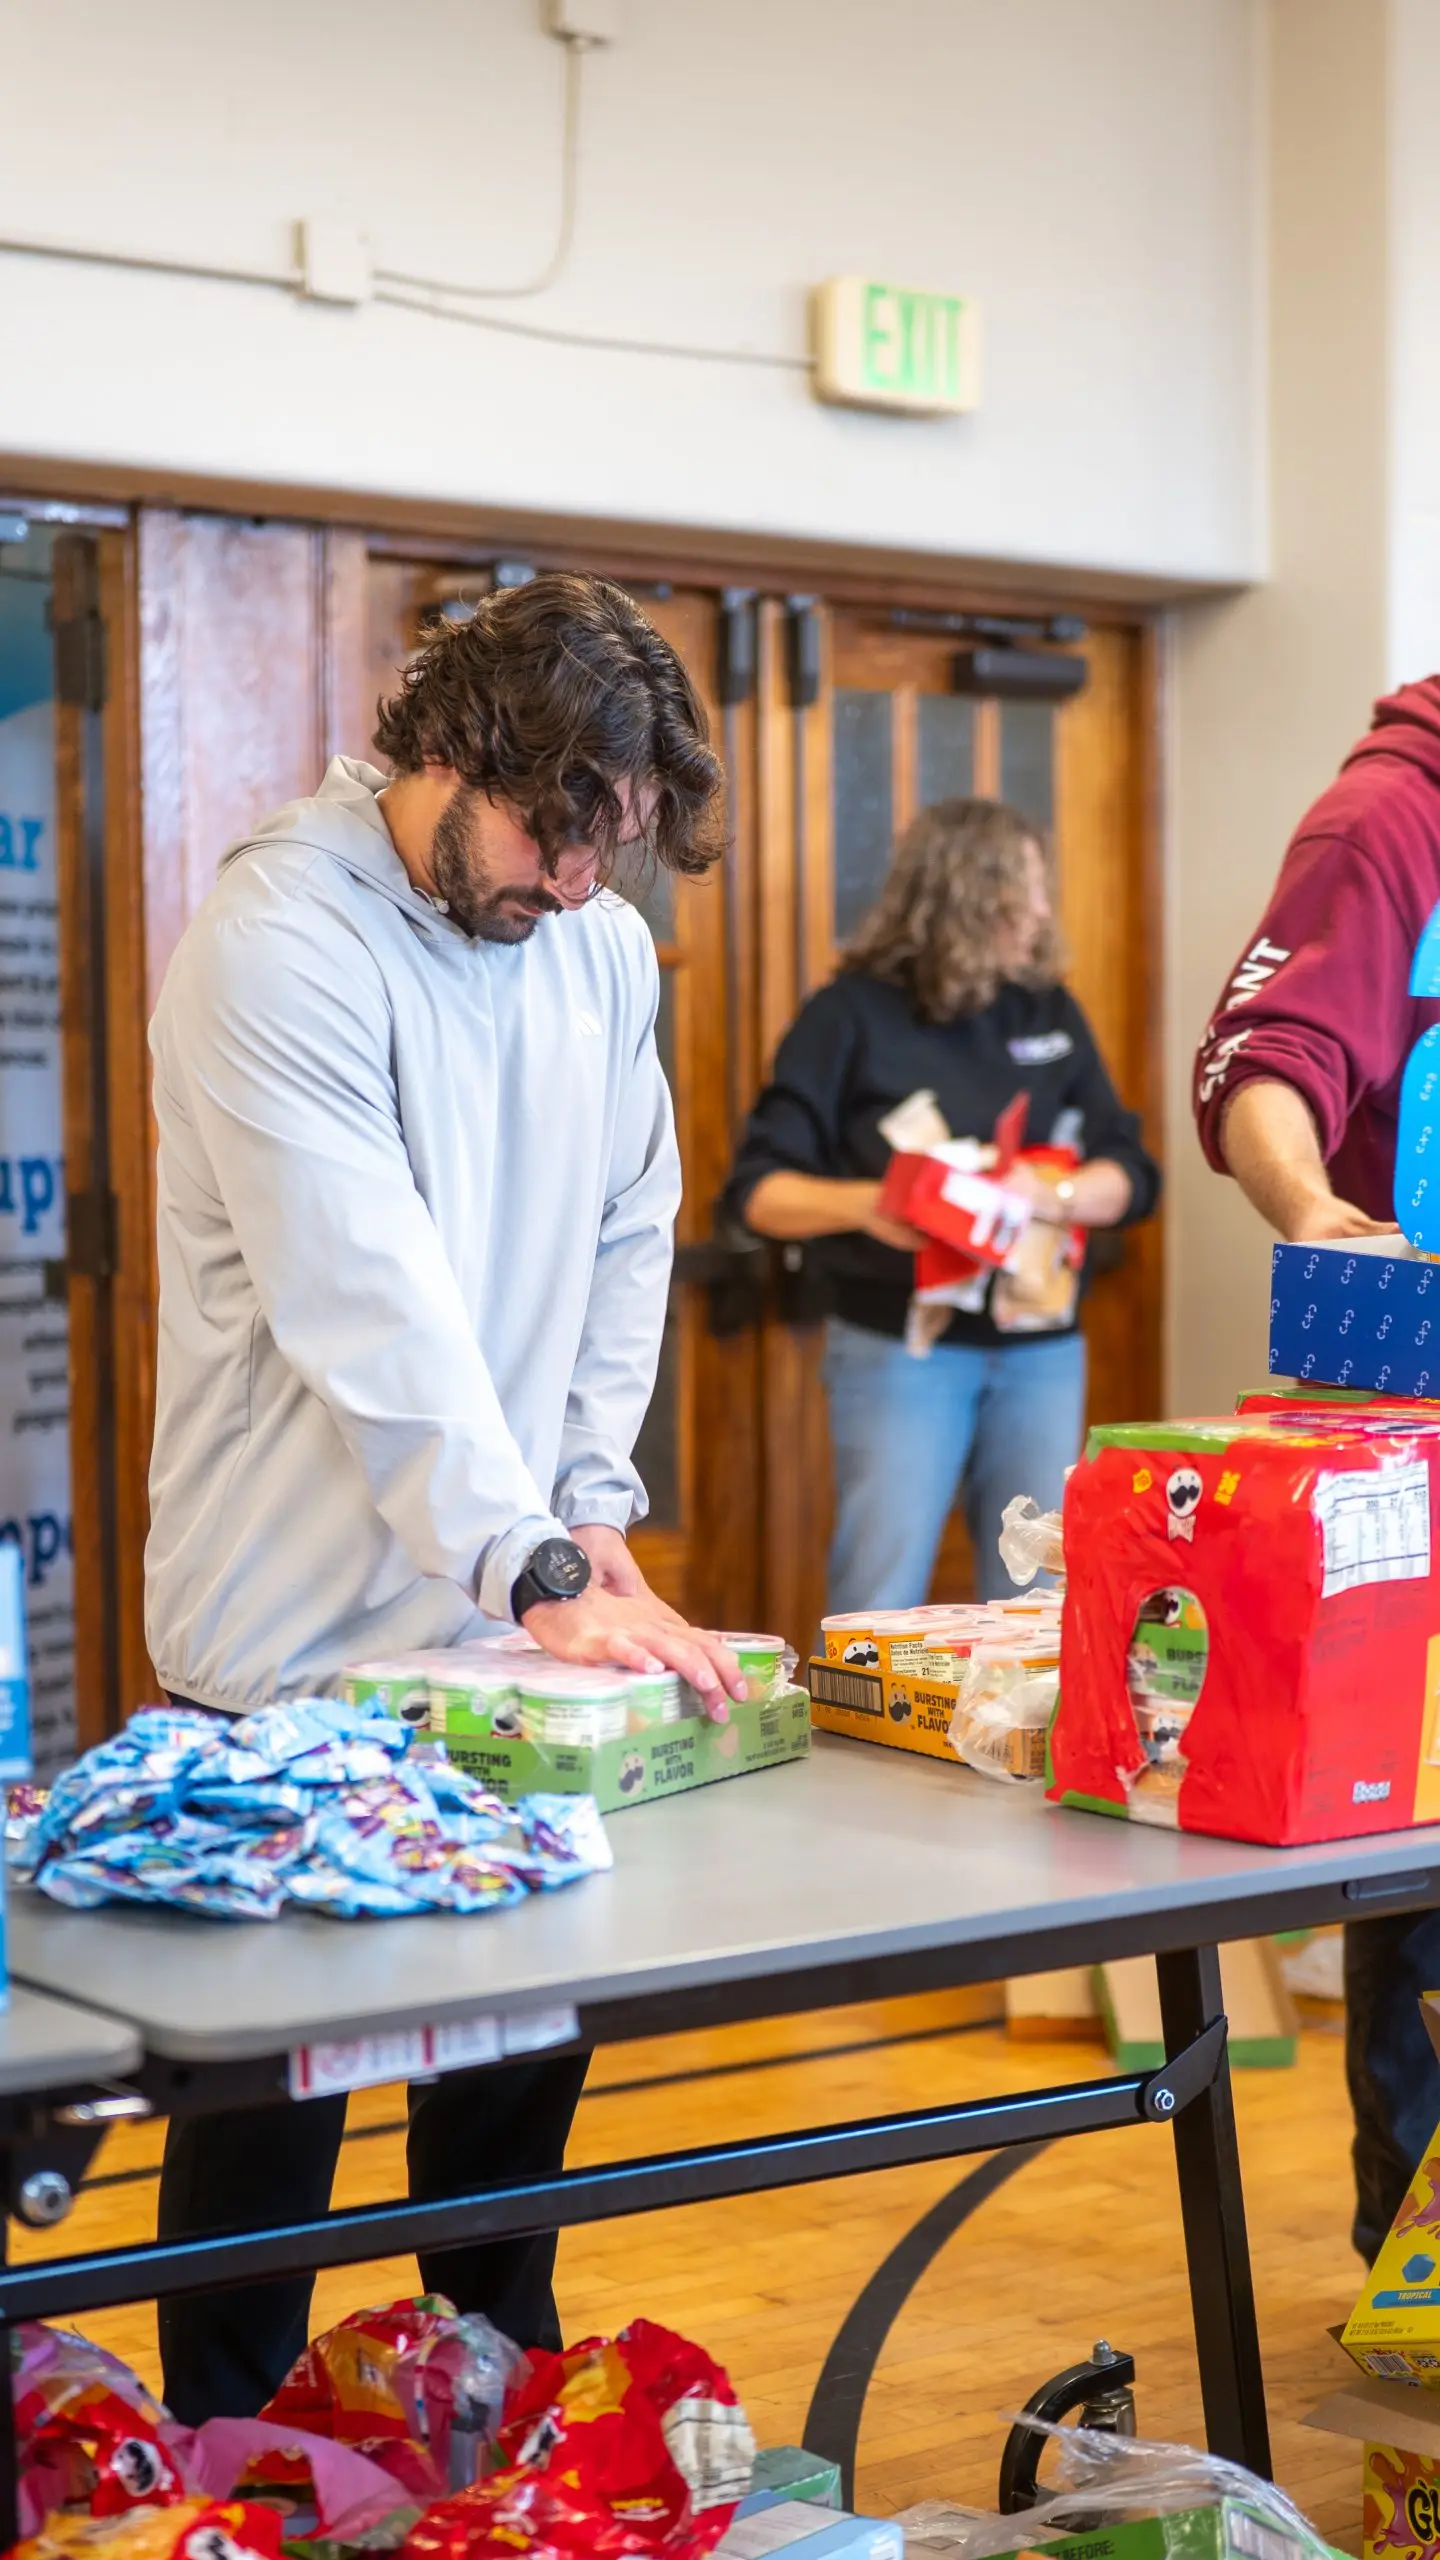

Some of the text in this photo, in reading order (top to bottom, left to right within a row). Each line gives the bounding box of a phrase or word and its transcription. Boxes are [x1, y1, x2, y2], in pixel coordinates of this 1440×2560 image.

[863, 283, 963, 398] EXIT
[914, 1691, 957, 1710] BURSTING
[927, 1706, 945, 1718] WITH
[917, 1714, 952, 1734] FLAVO
[651, 1736, 695, 1760] BURSTING
[654, 1761, 694, 1786] FLAVOR
[1397, 2291, 1432, 2300] TROPICAL
